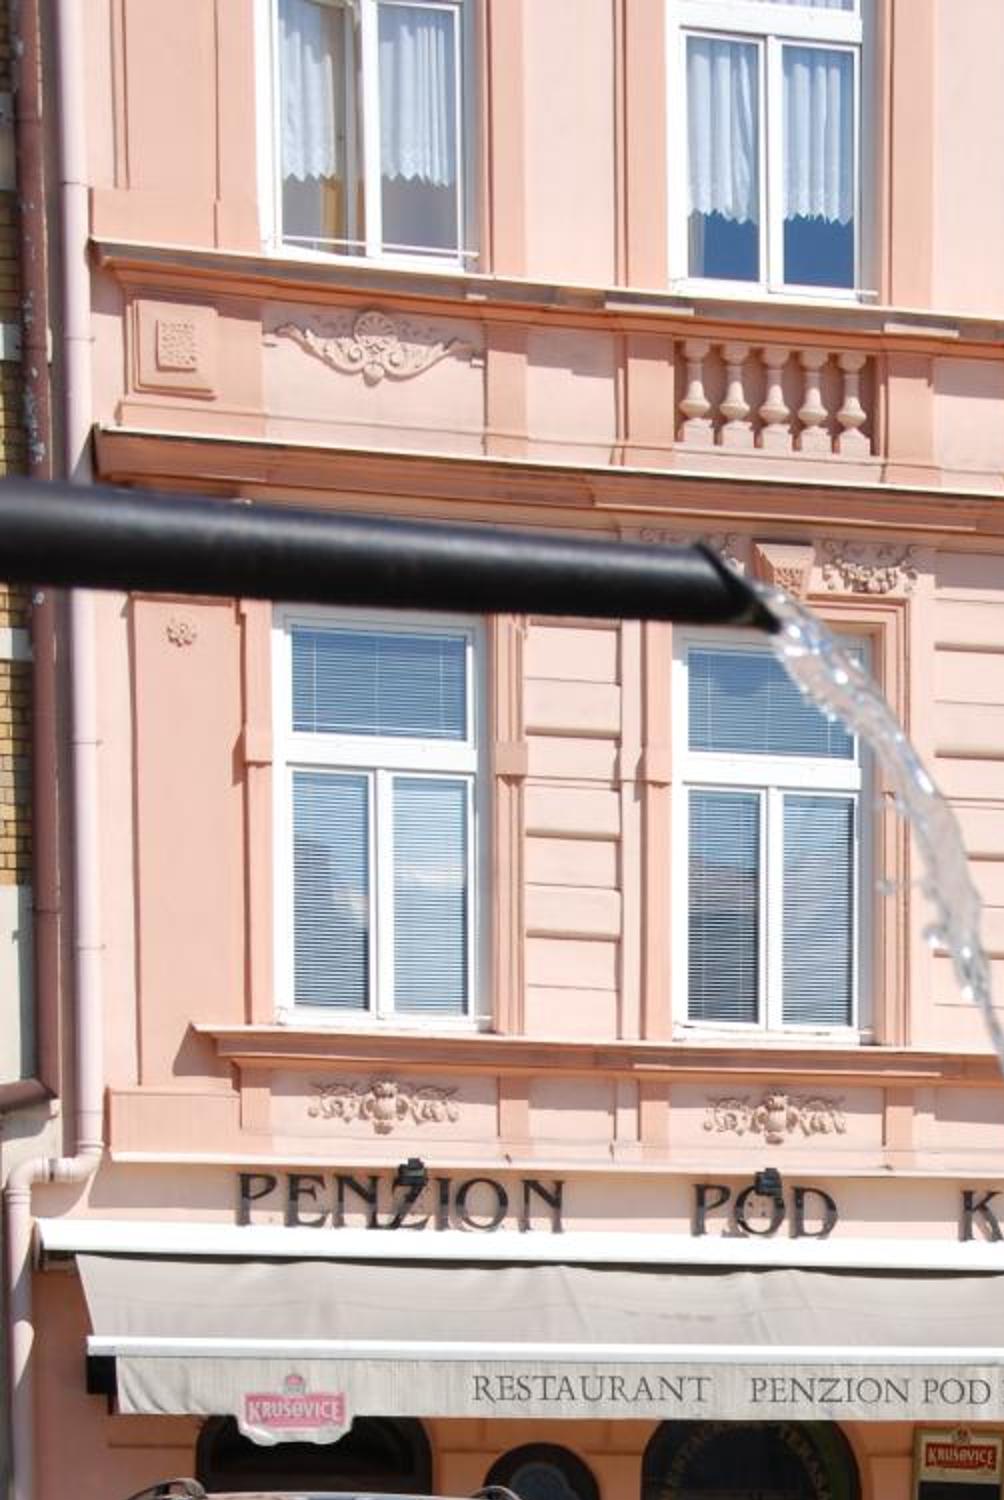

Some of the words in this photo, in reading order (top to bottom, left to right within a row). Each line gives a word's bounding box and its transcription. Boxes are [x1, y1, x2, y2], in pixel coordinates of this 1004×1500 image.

[234, 1172, 565, 1233] PENZION
[690, 1183, 839, 1239] POD
[471, 1374, 712, 1403] RESTAURANT
[750, 1376, 910, 1404] PENZION
[923, 1377, 992, 1405] POD
